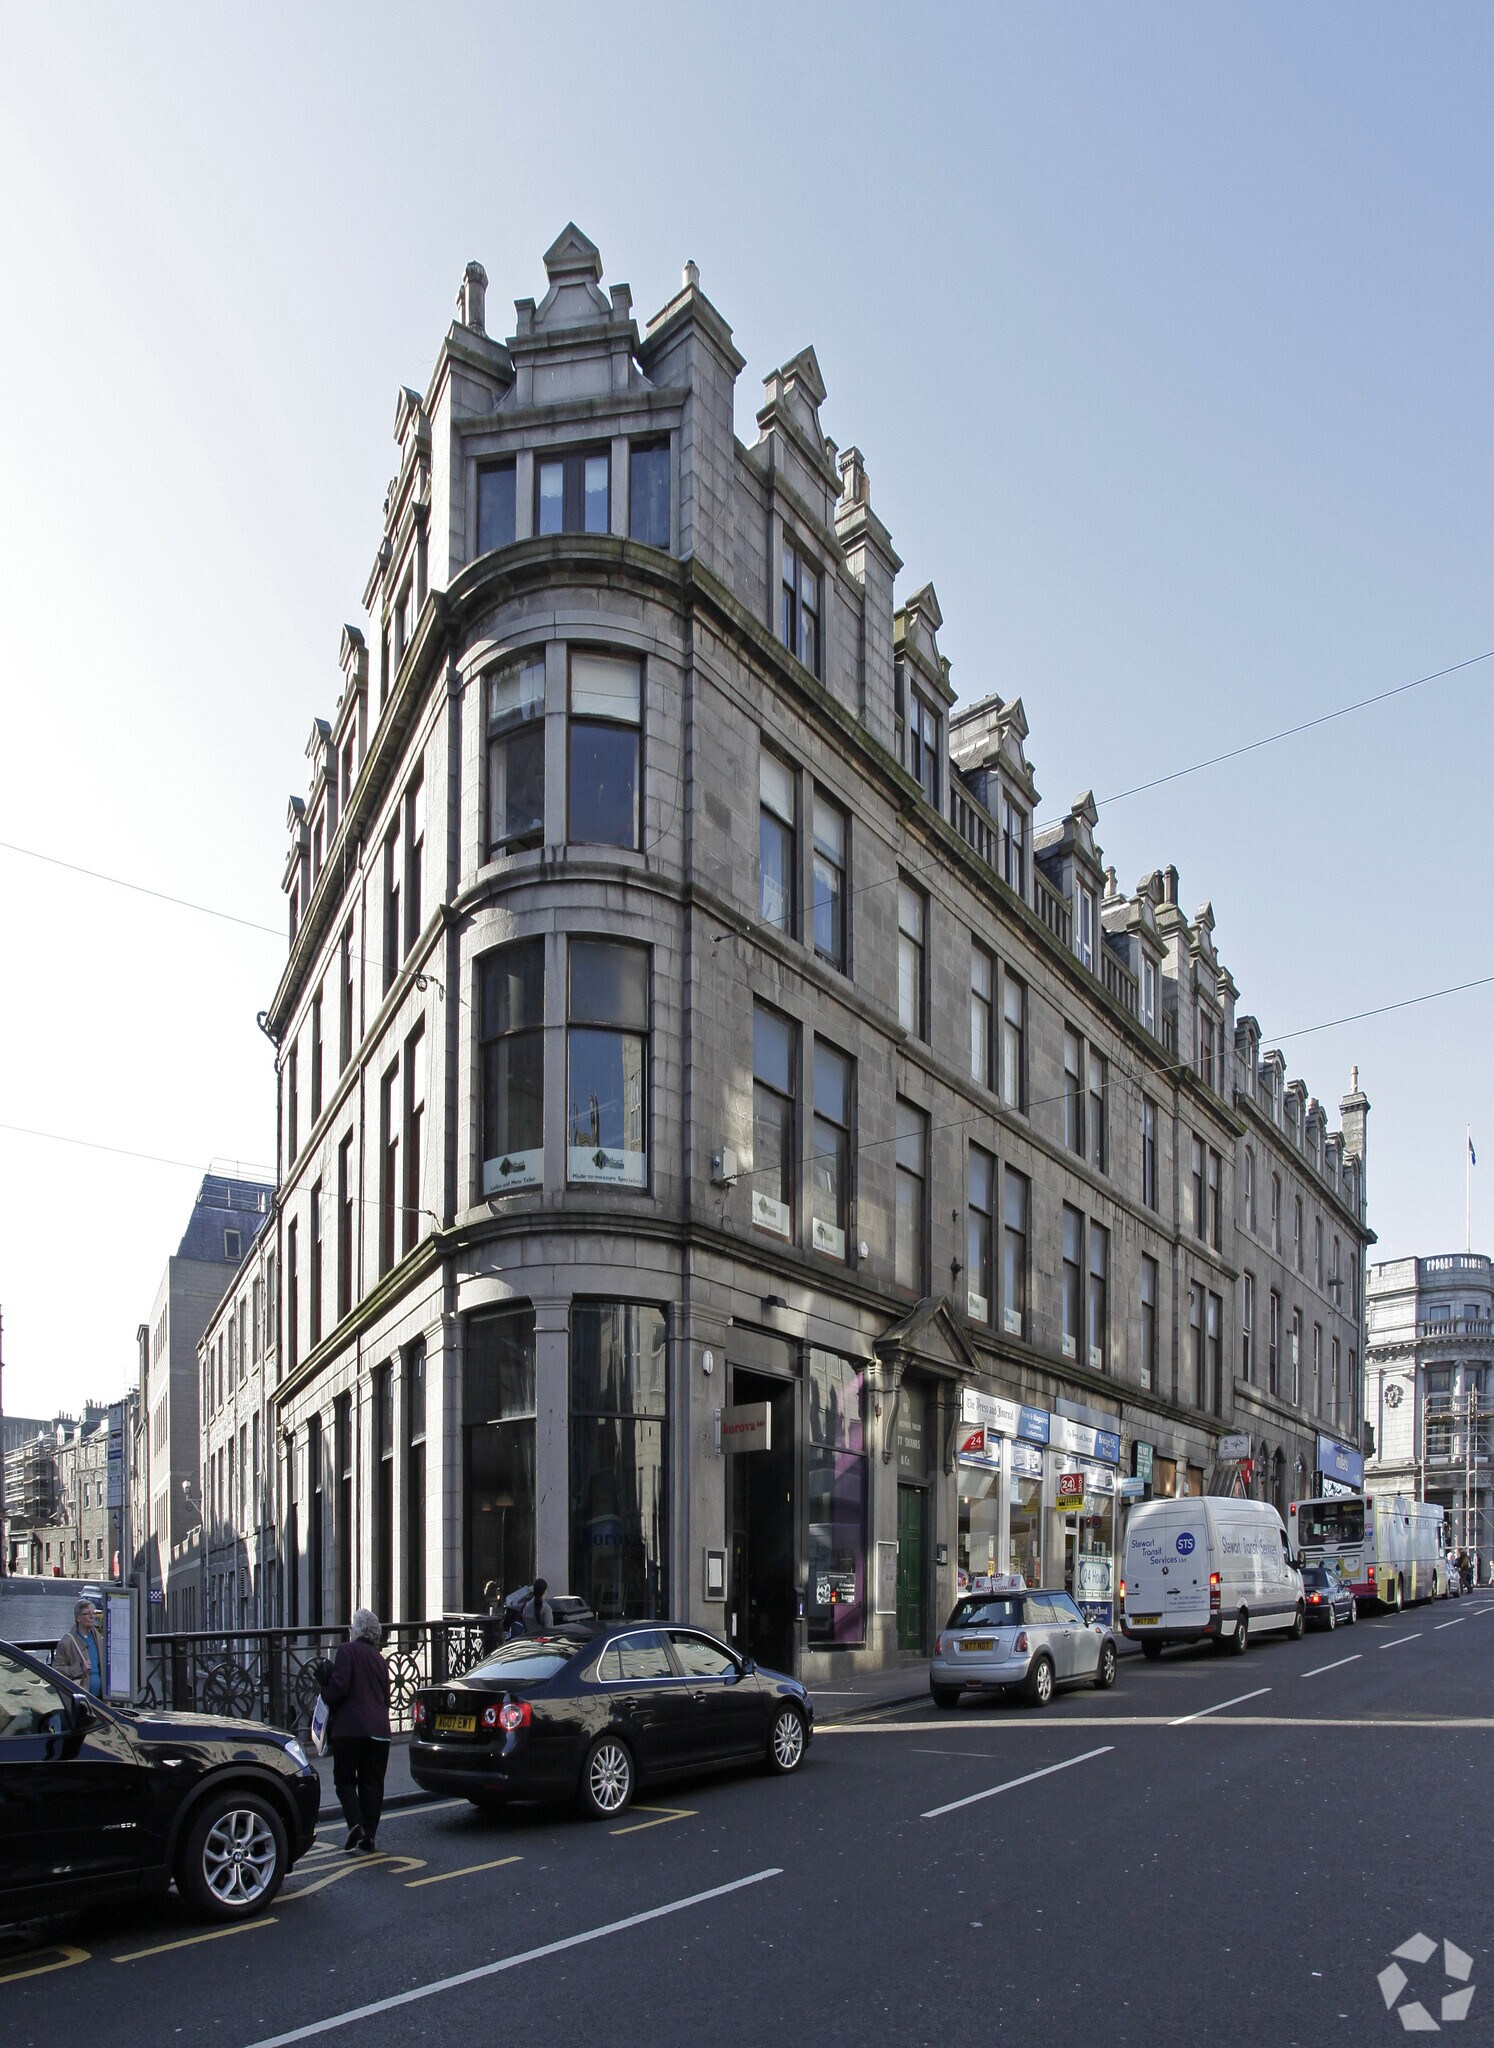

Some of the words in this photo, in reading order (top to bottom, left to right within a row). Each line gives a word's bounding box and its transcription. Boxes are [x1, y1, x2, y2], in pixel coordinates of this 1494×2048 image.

[966, 1397, 975, 1409] The
[976, 1397, 989, 1414] Press
[989, 1404, 997, 1416] and
[996, 1404, 1014, 1421] Journal
[723, 1422, 756, 1435] korova
[970, 1436, 982, 1446] 24
[1098, 1434, 1110, 1448] Bridge
[1102, 1447, 1113, 1459] News
[1062, 1479, 1073, 1489] 24
[1131, 1538, 1155, 1549] Stewart
[1177, 1538, 1194, 1550] STS
[1221, 1536, 1242, 1554] Stewart
[1242, 1537, 1259, 1555] Transit
[1259, 1538, 1278, 1556] Services
[1142, 1547, 1163, 1557] Transit
[1150, 1555, 1178, 1565] Services
[1084, 1568, 1091, 1583] 24
[1092, 1569, 1107, 1585] Hours
[975, 1580, 982, 1589] L
[1010, 1579, 1017, 1588] L
[439, 1716, 456, 1729] AG07
